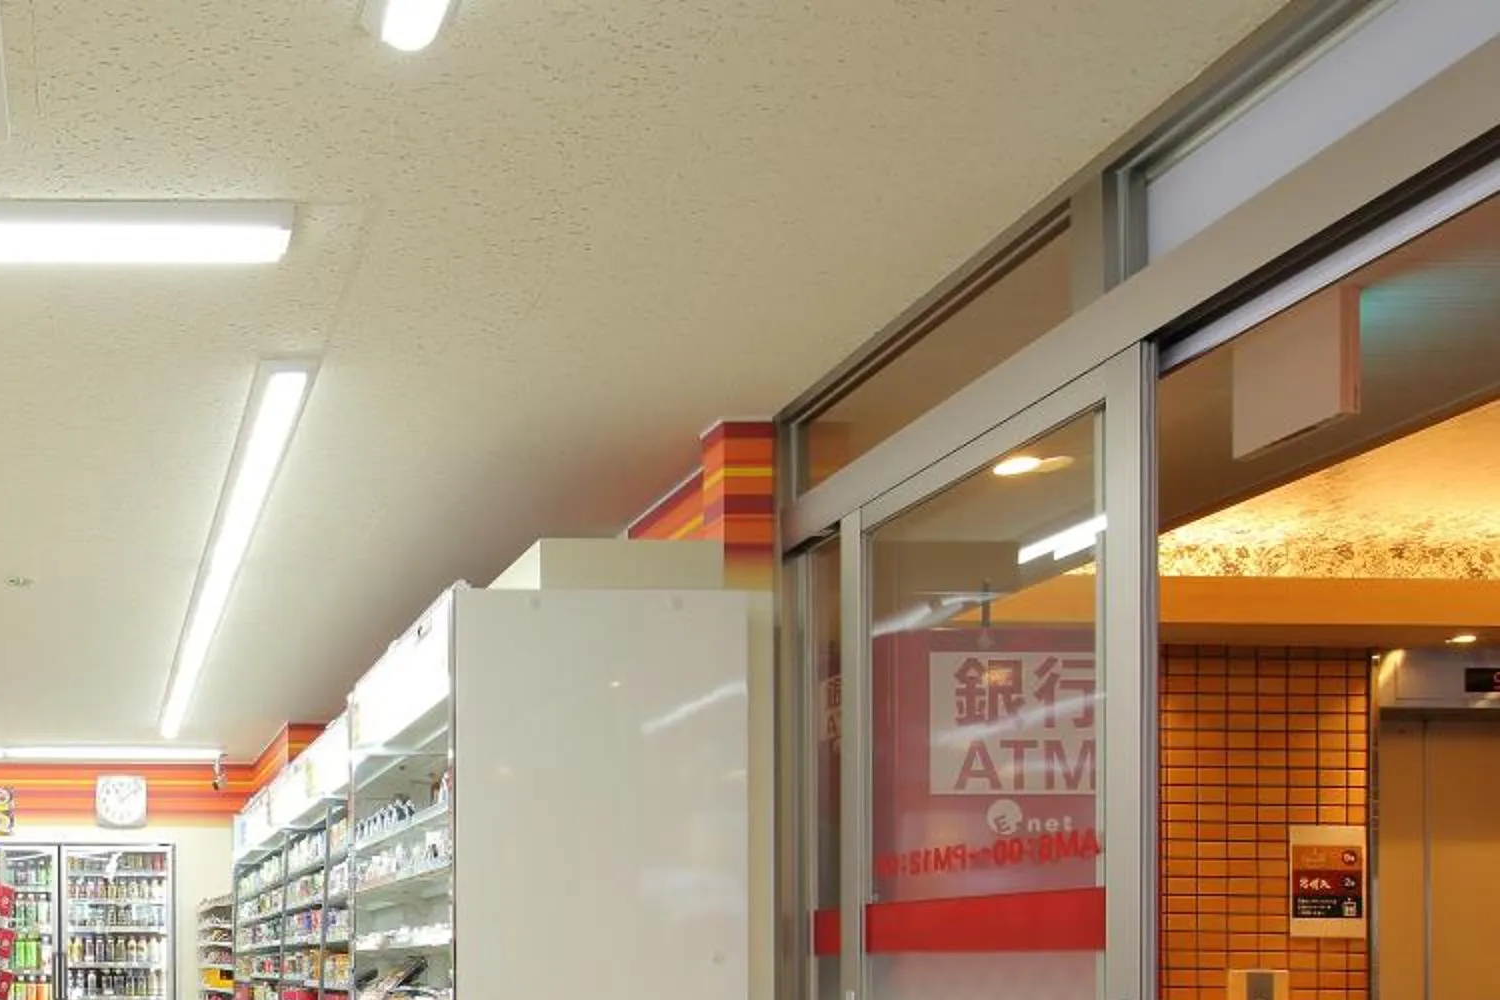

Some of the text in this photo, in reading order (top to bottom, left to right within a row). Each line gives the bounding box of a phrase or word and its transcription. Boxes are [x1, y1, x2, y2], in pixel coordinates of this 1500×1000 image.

[953, 655, 1096, 729] 銀行
[954, 739, 1096, 791] ATM
[1027, 816, 1073, 832] net
